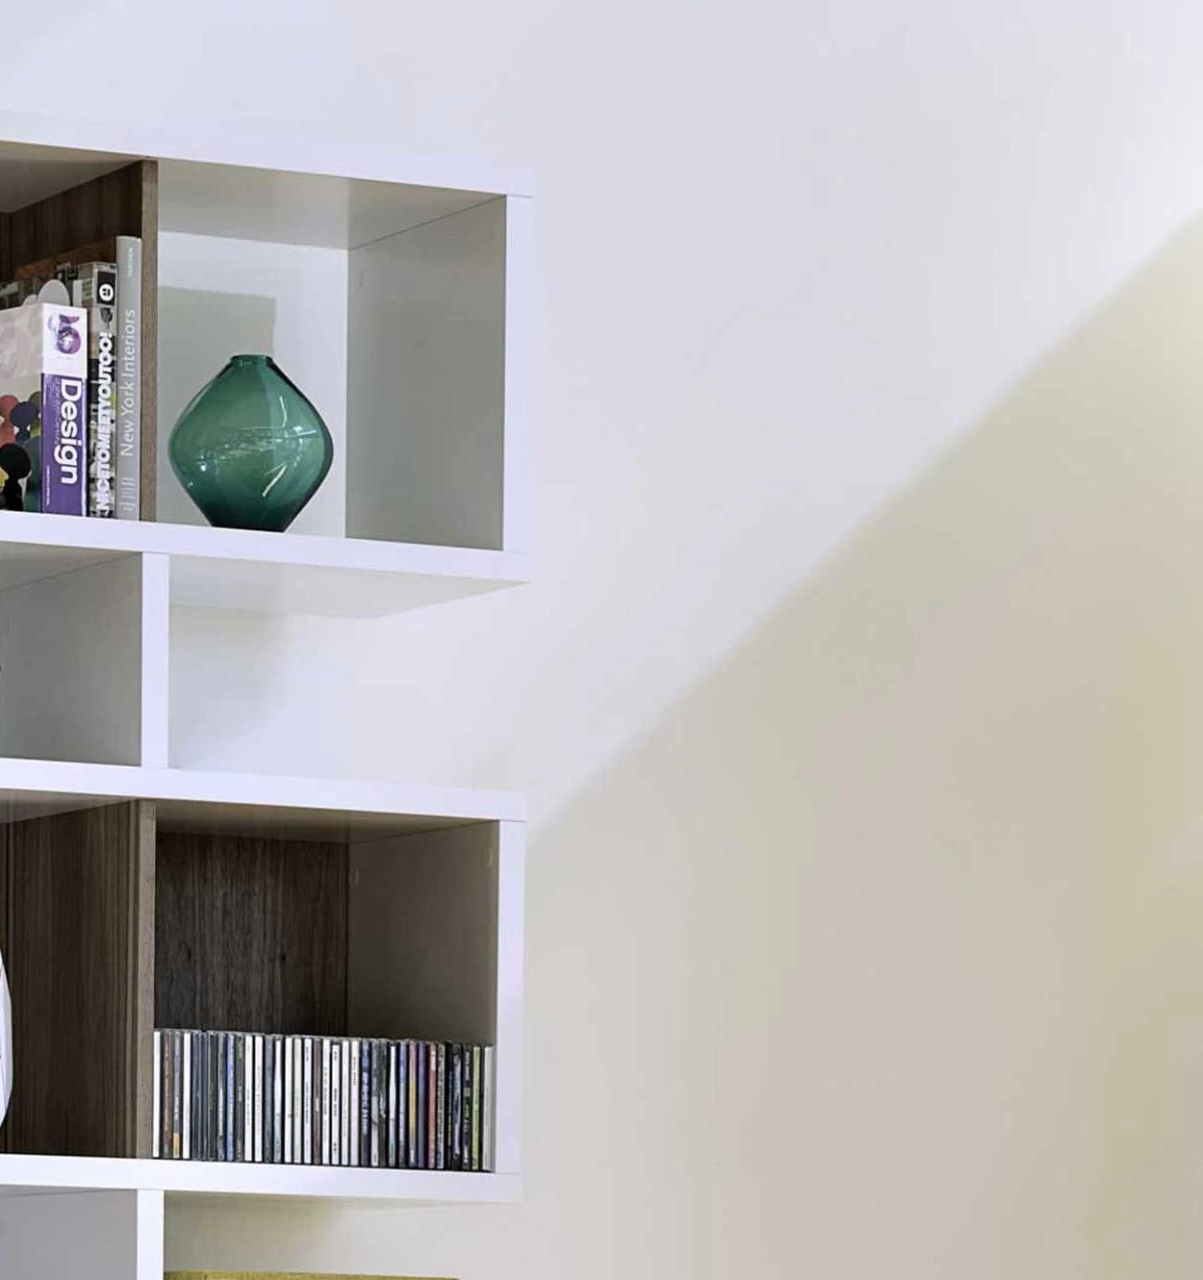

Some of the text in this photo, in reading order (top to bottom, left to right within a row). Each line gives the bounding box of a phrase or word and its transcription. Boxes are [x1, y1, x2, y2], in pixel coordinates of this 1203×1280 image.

[54, 379, 82, 484] Design
[120, 309, 136, 457] New York Interiors
